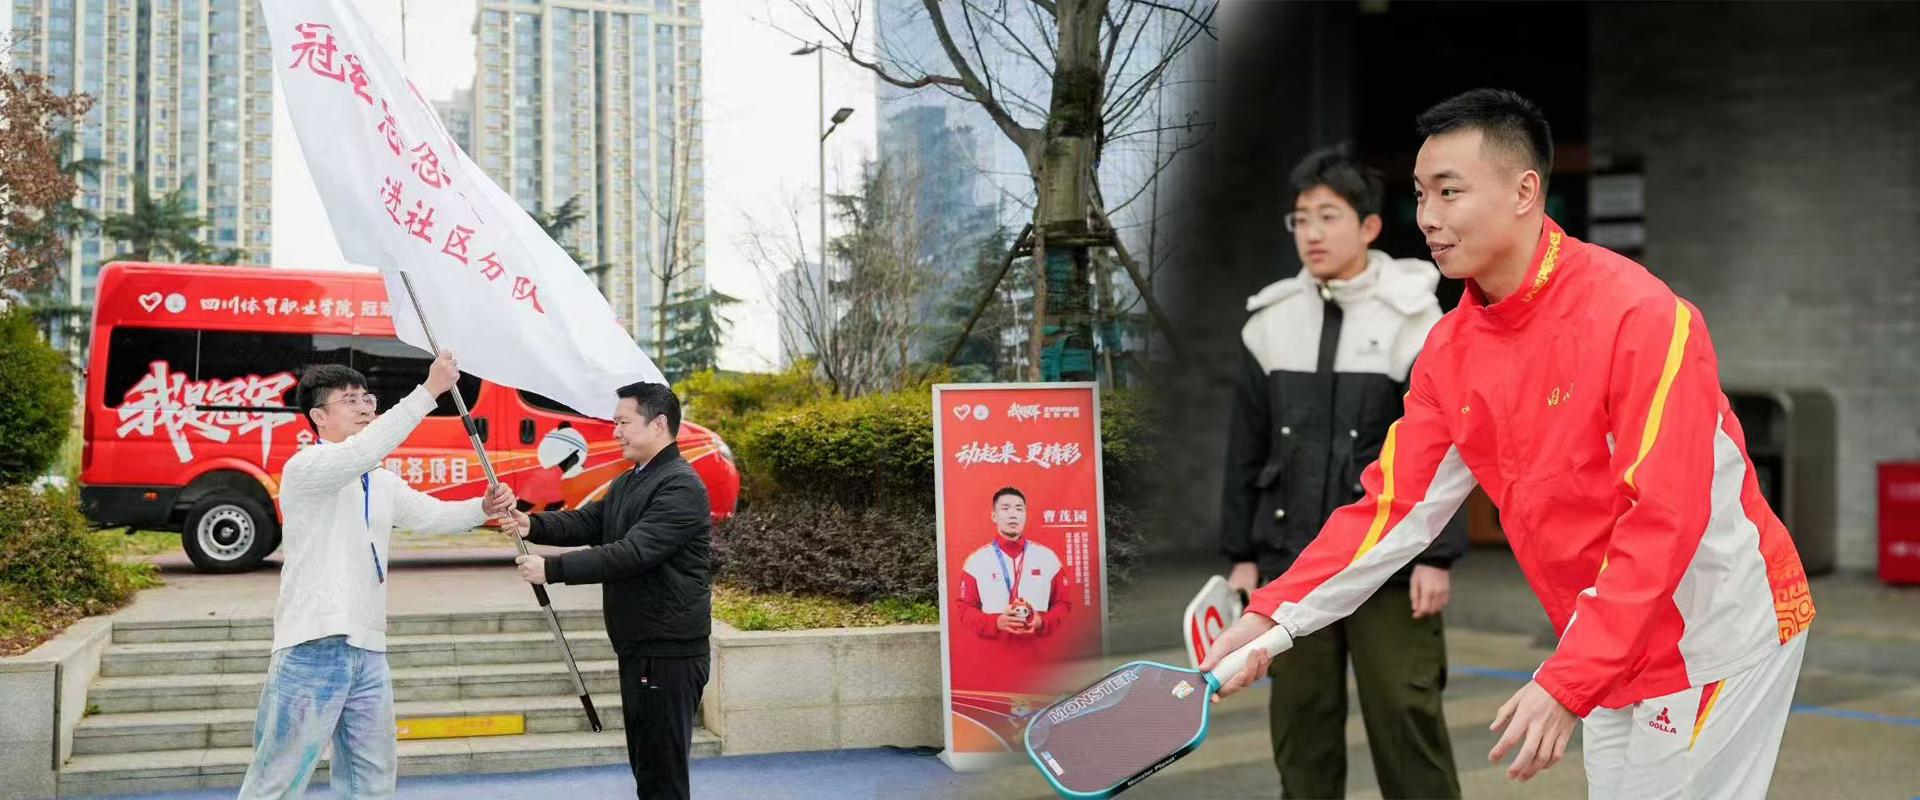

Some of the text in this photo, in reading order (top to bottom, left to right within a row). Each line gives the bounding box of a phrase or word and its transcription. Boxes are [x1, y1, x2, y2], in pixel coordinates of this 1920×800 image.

[380, 176, 545, 314] 进社区分队
[199, 295, 354, 318] 四川体育职业学院
[116, 360, 297, 468] 我是冠军
[954, 441, 1082, 469] 动起来 更精彩
[1048, 670, 1139, 724] MONSTER
[1127, 769, 1154, 787] Monster
